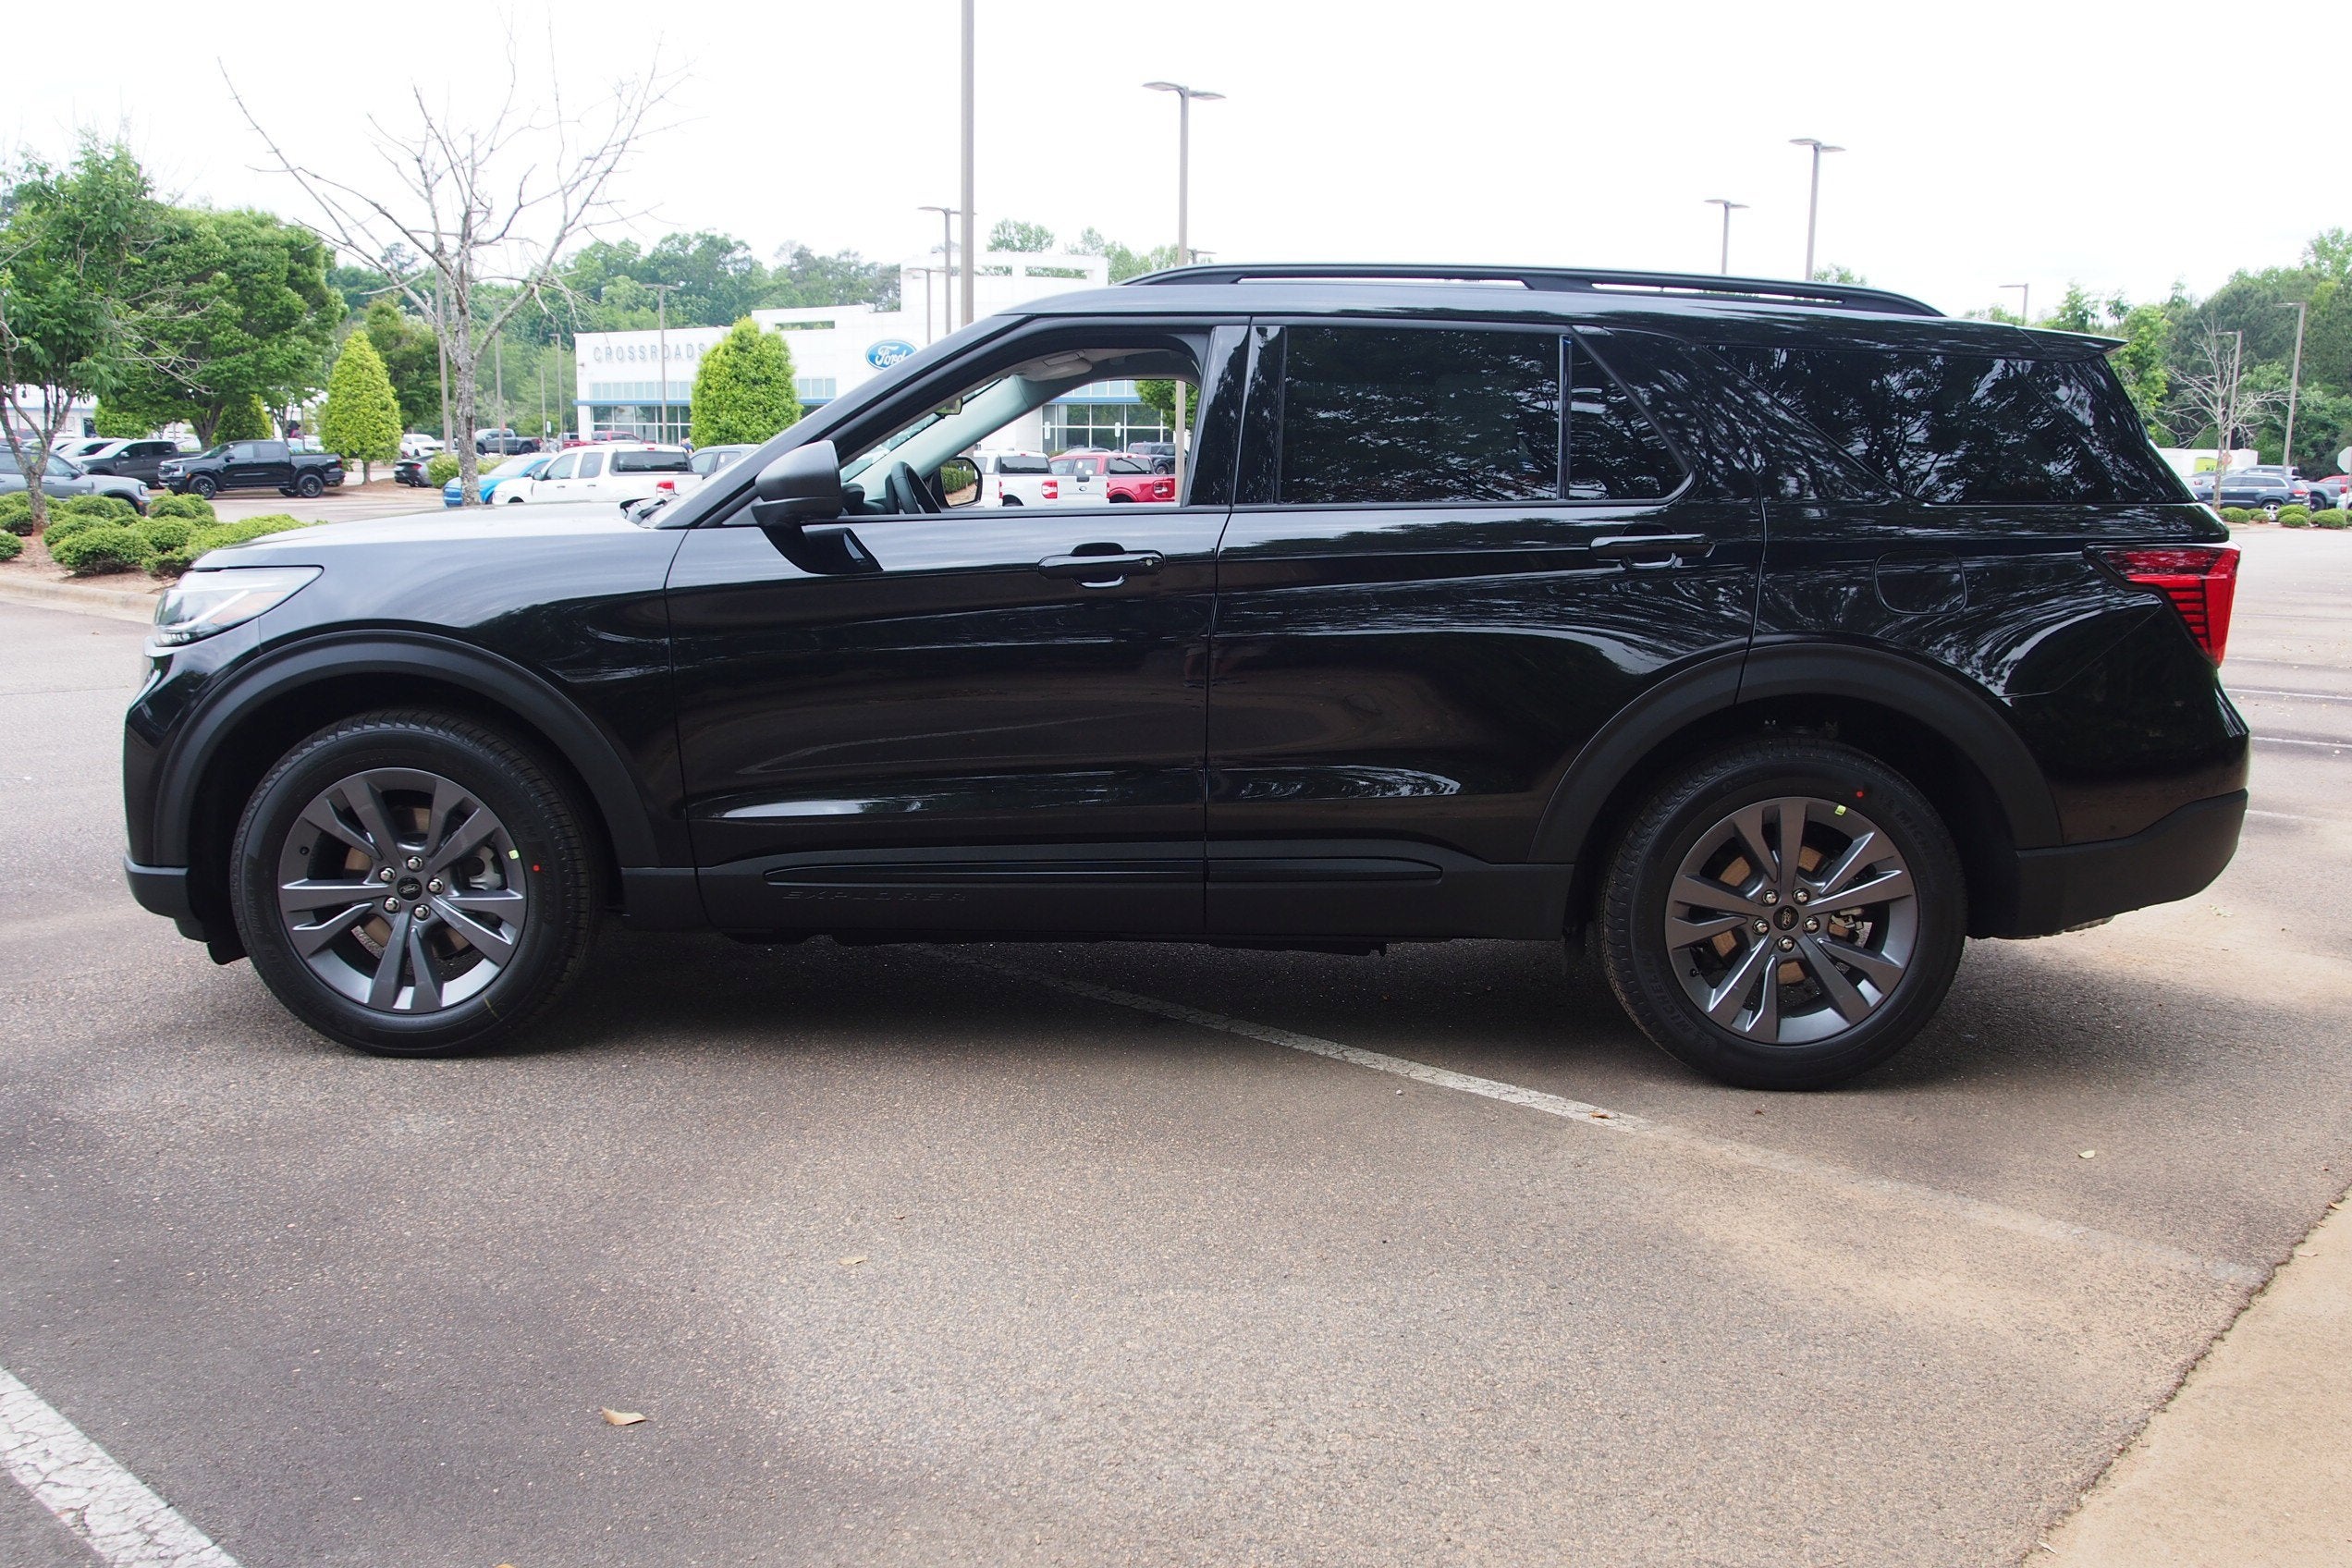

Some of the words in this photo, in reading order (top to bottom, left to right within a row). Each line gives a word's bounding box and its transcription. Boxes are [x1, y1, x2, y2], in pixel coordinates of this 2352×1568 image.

[593, 342, 705, 362] CROSSROADS
[875, 345, 907, 366] Ford
[782, 890, 967, 901] EXPLORER
